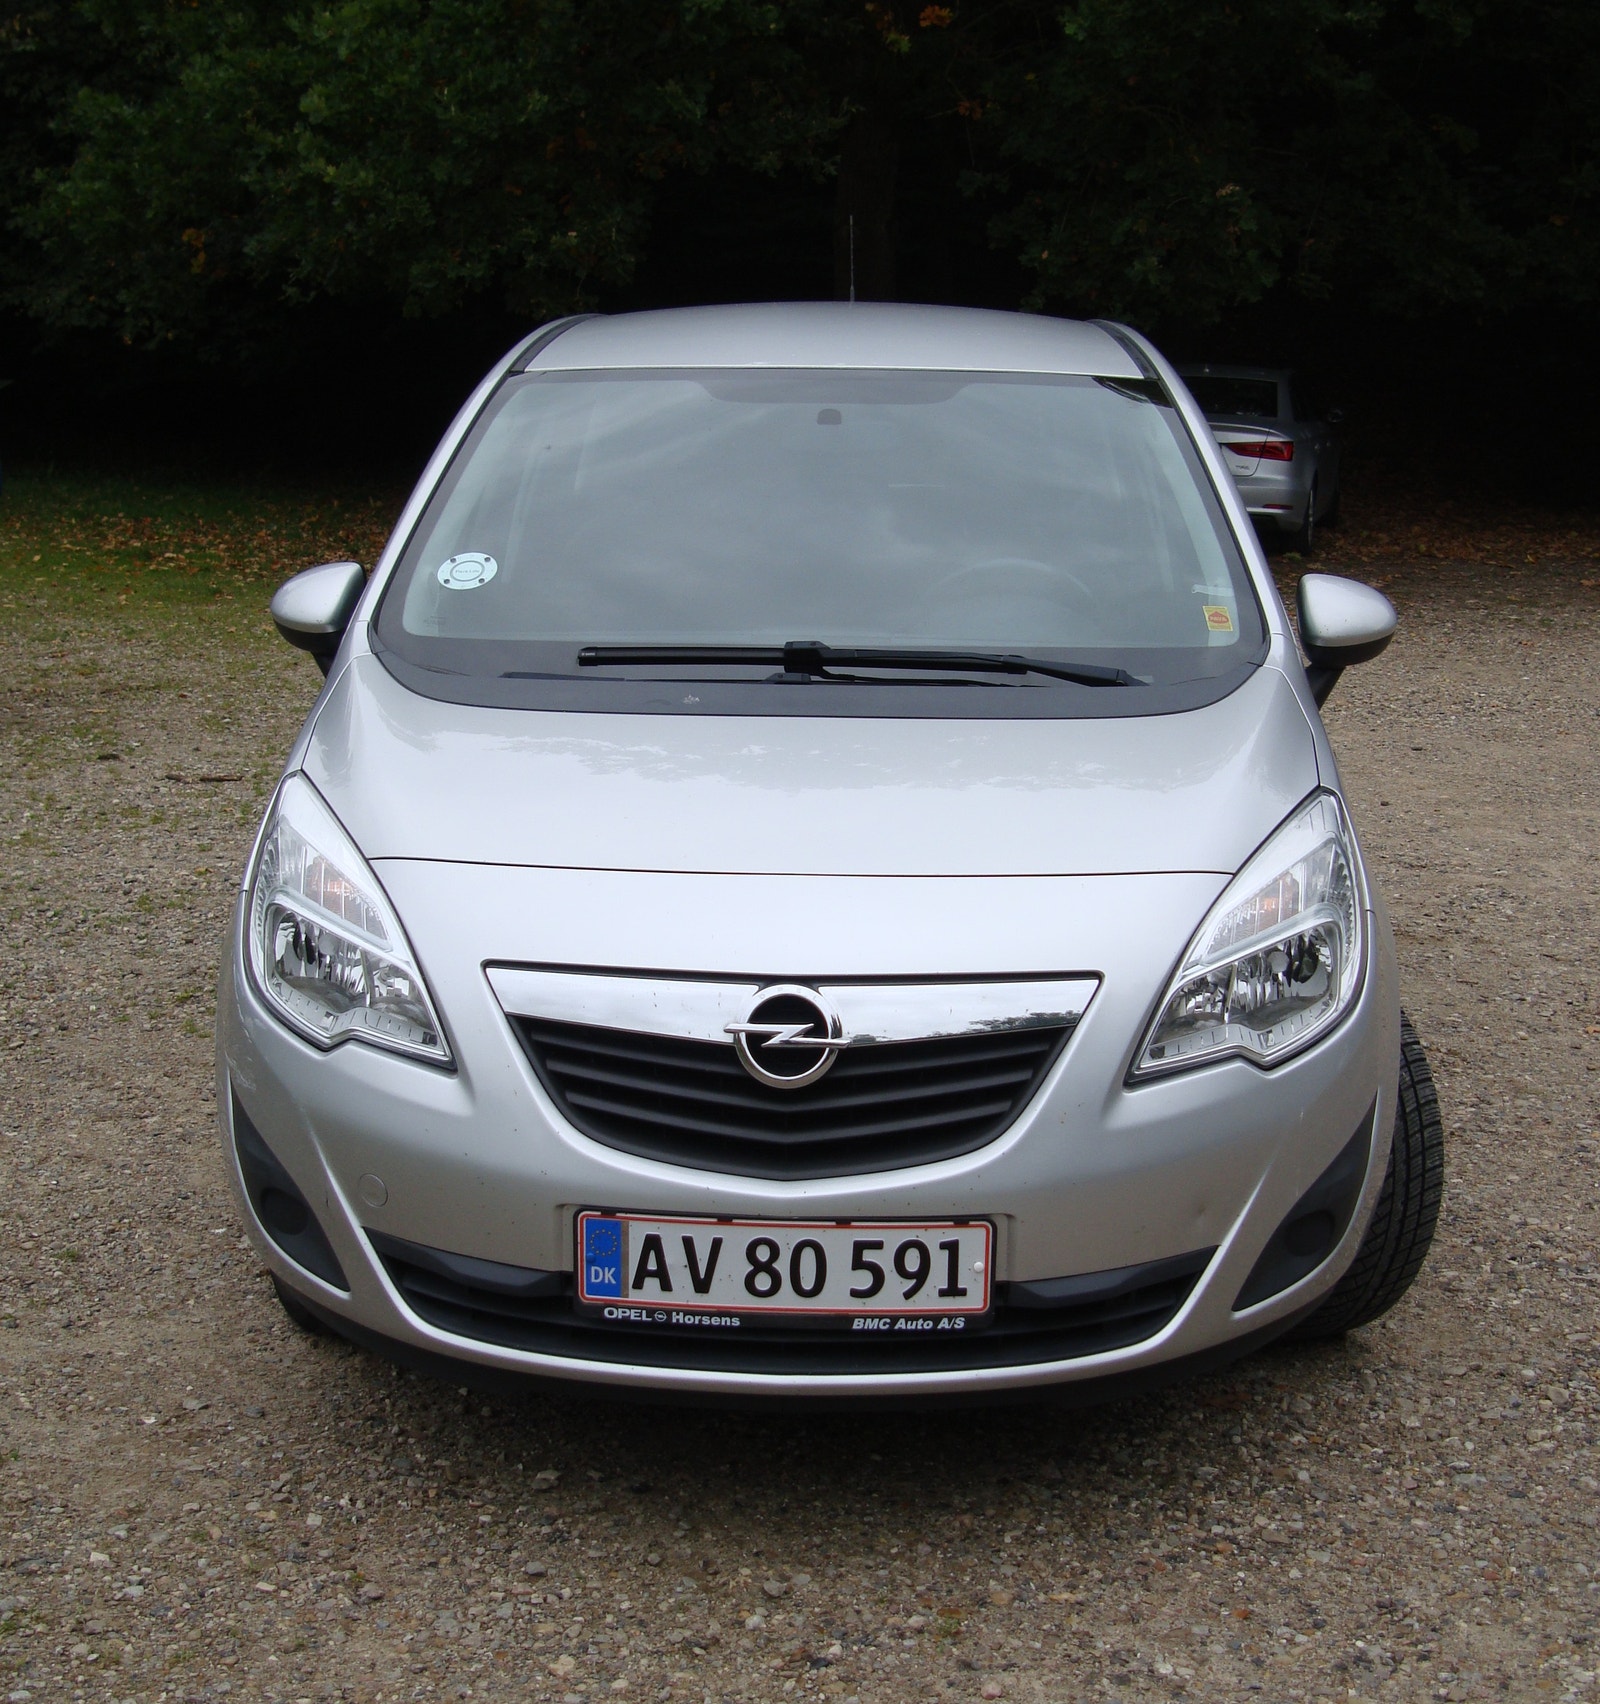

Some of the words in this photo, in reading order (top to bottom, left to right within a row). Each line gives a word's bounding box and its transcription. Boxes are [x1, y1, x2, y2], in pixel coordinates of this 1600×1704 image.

[591, 1266, 616, 1284] DK
[632, 1233, 723, 1294] AV
[744, 1236, 827, 1298] 80
[850, 1238, 967, 1300] 591
[604, 1307, 652, 1321] OPEL
[671, 1312, 741, 1326] Horsens
[852, 1318, 890, 1330] BMC
[894, 1318, 933, 1330] Auto
[937, 1316, 966, 1330] A/S
